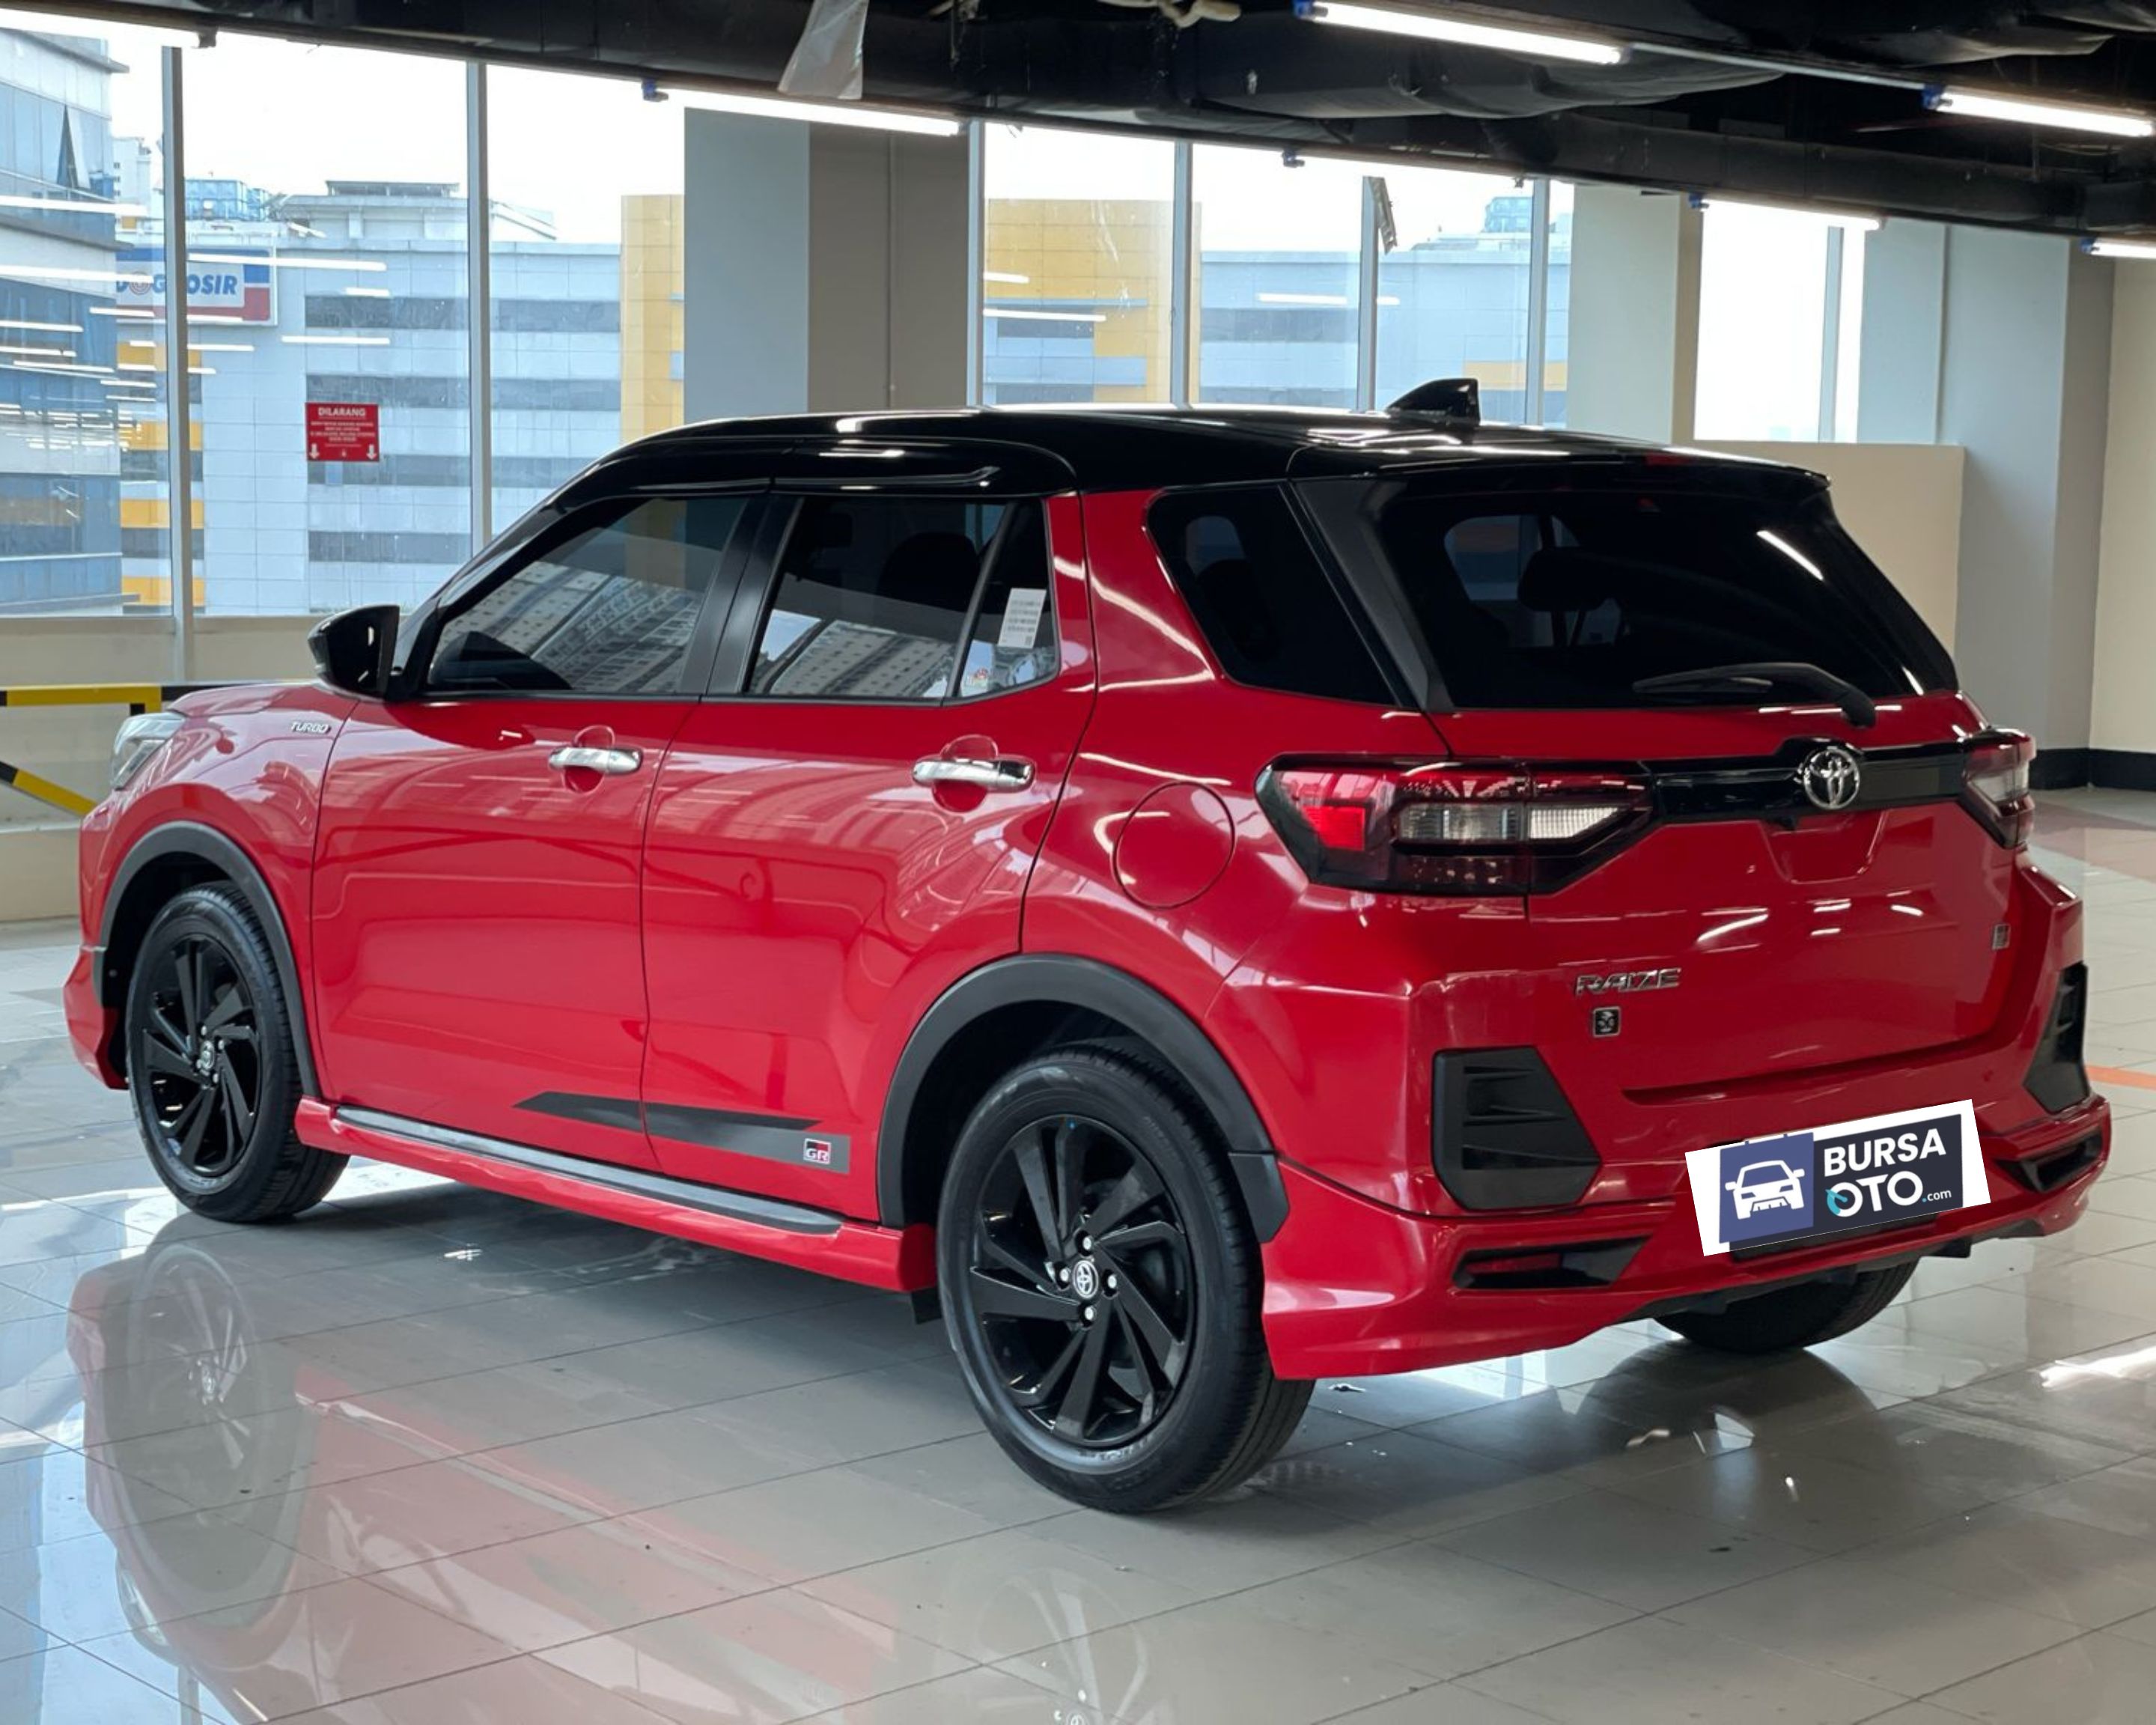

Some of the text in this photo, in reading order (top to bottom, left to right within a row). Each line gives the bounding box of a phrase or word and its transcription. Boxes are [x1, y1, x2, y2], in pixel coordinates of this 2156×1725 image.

[318, 407, 366, 416] DILARANG
[291, 721, 330, 734] TURBO
[1575, 967, 1681, 997] RAIZE
[806, 1148, 829, 1161] GR
